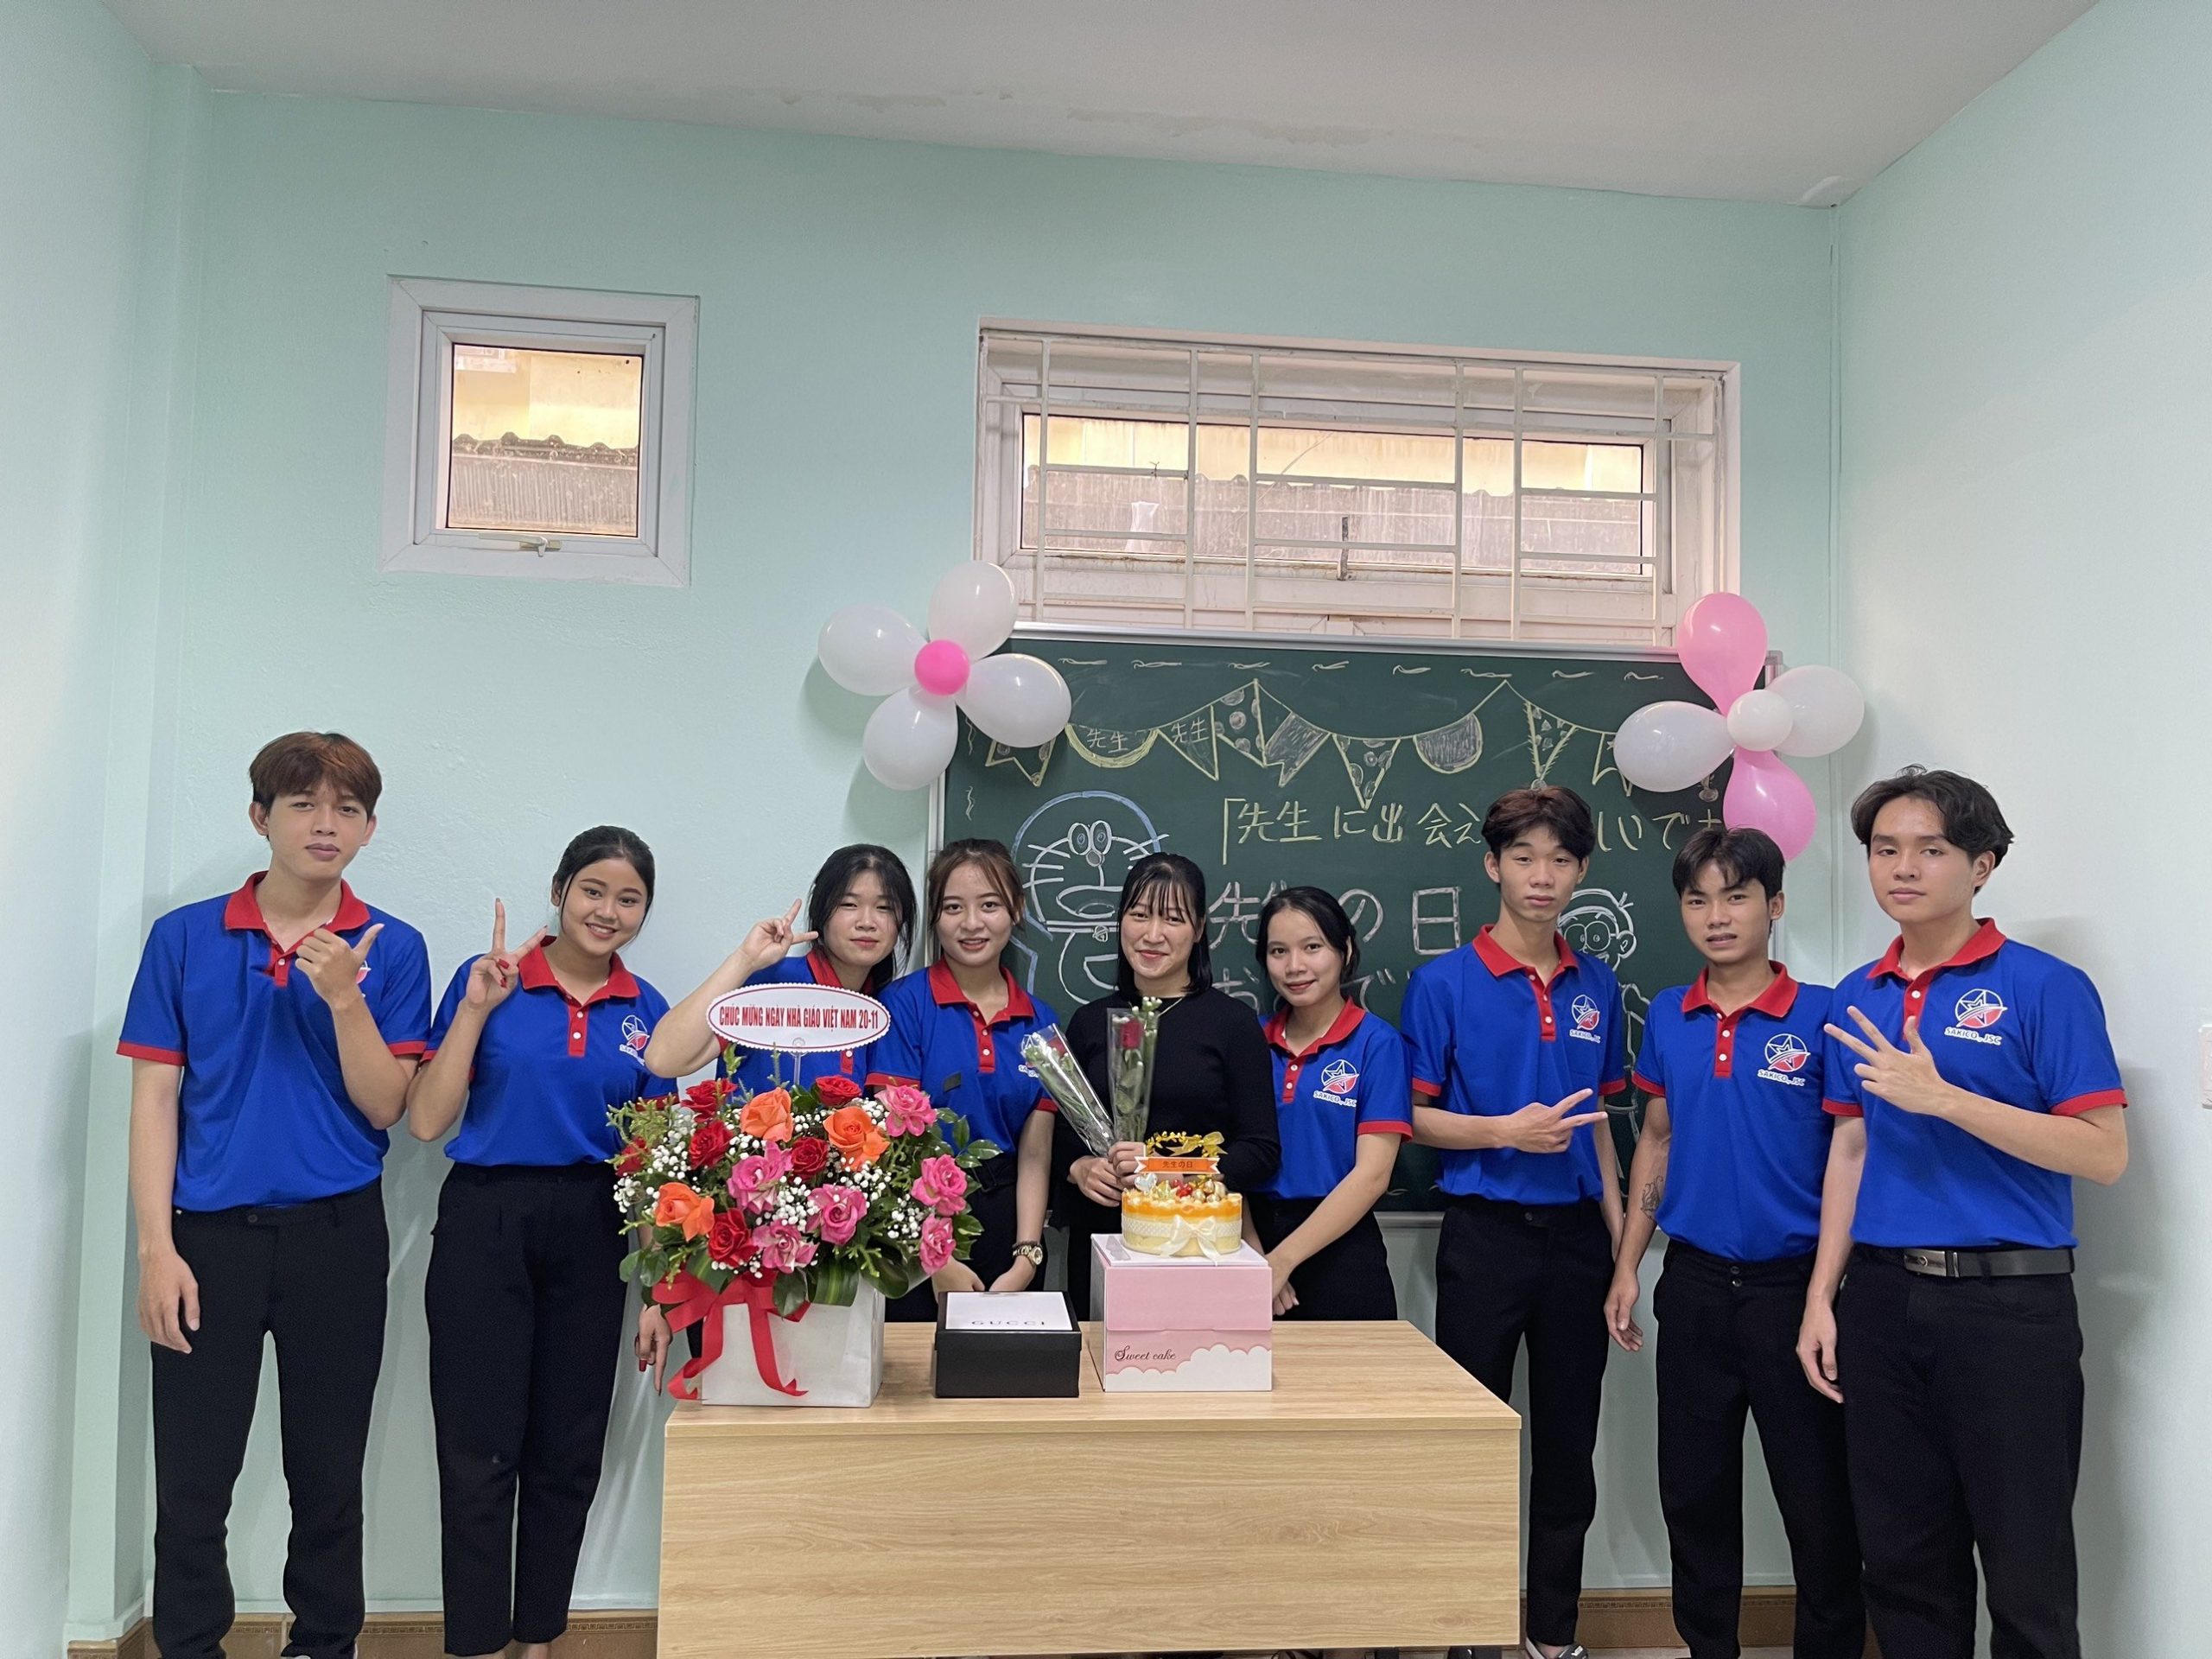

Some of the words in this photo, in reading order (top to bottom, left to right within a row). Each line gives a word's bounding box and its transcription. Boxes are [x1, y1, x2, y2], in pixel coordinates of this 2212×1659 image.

[1087, 728, 1131, 753] 先生
[1171, 716, 1211, 745] 先生
[1208, 880, 1462, 956] 先の日
[719, 1003, 740, 1027] CHÚC
[765, 1004, 785, 1027] NGÀY
[786, 1004, 802, 1027] NHÀ
[803, 1004, 821, 1028] GIÁO
[823, 1004, 839, 1033] VIỆT
[840, 1008, 857, 1029] NAM
[858, 1009, 879, 1029] 20-11
[1114, 1345, 1150, 1362] Sweet
[1152, 1349, 1177, 1360] cake
